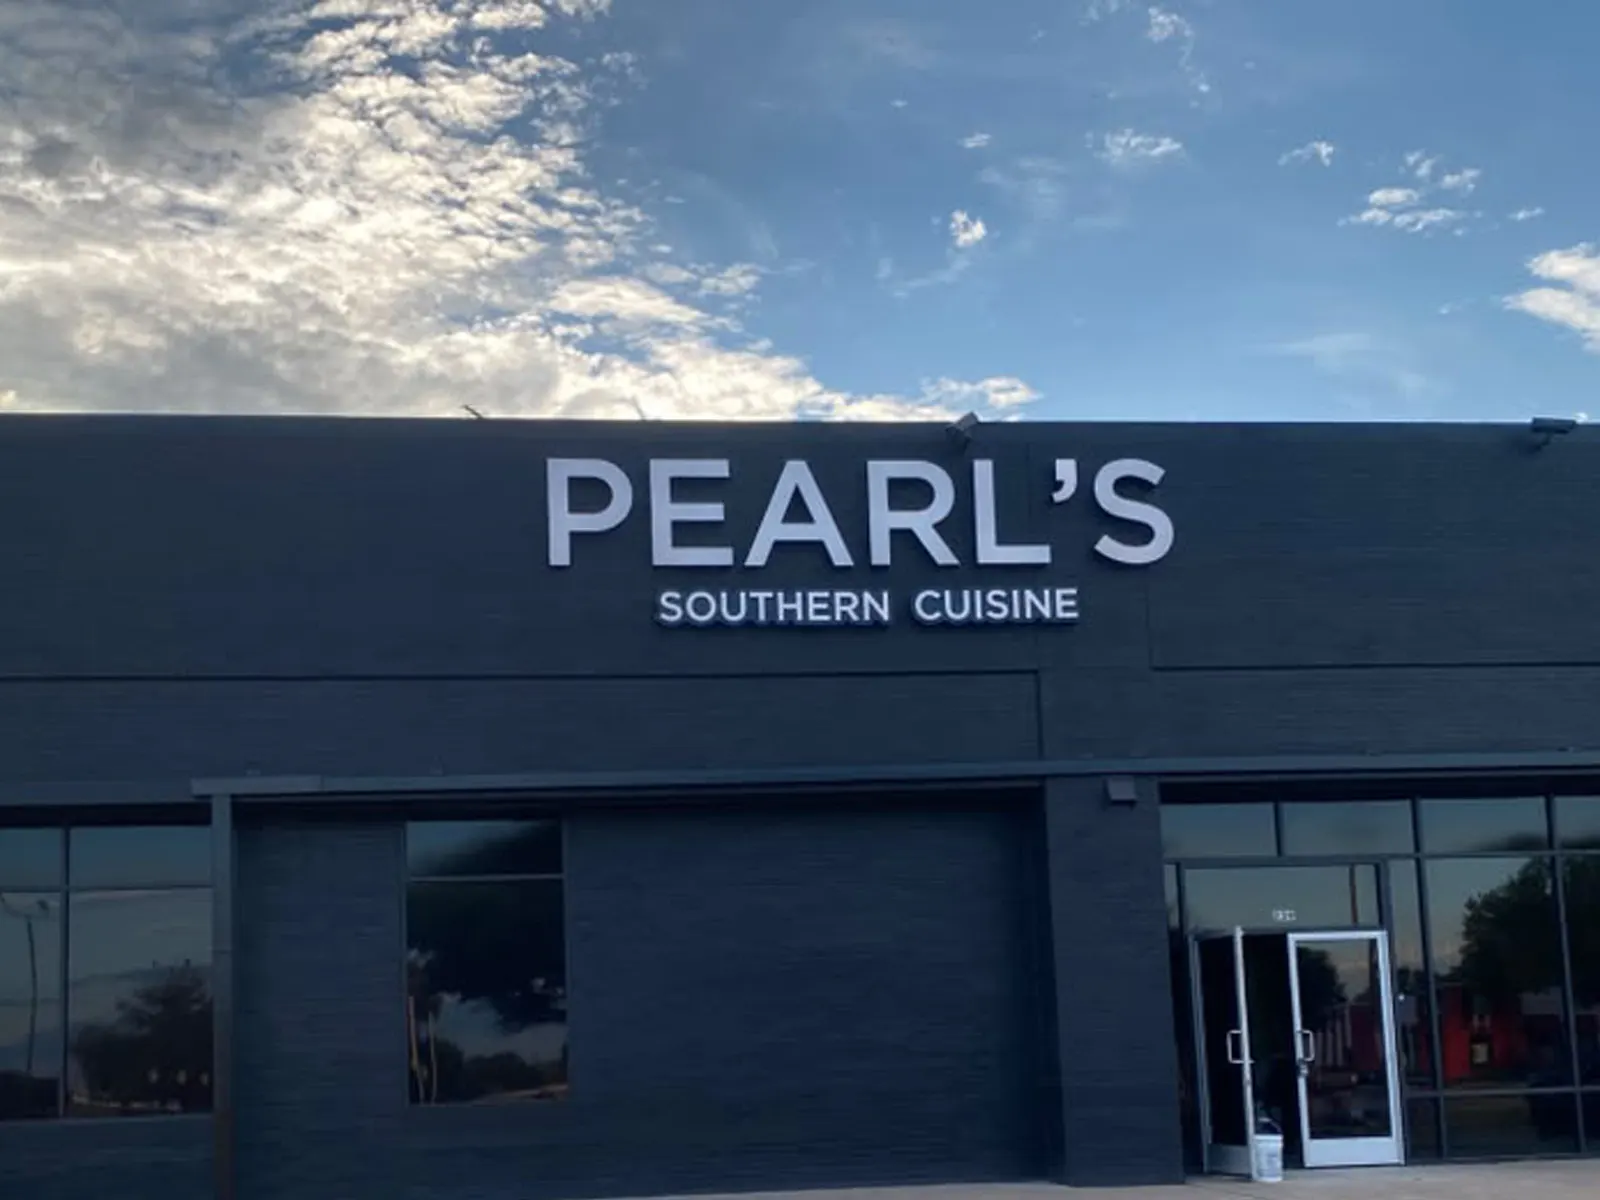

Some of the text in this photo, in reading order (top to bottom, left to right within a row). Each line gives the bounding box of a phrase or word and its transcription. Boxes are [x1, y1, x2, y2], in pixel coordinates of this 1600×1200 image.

[546, 457, 1174, 566] PEARL'S
[658, 587, 1079, 623] SOUTHERN CUISINE
